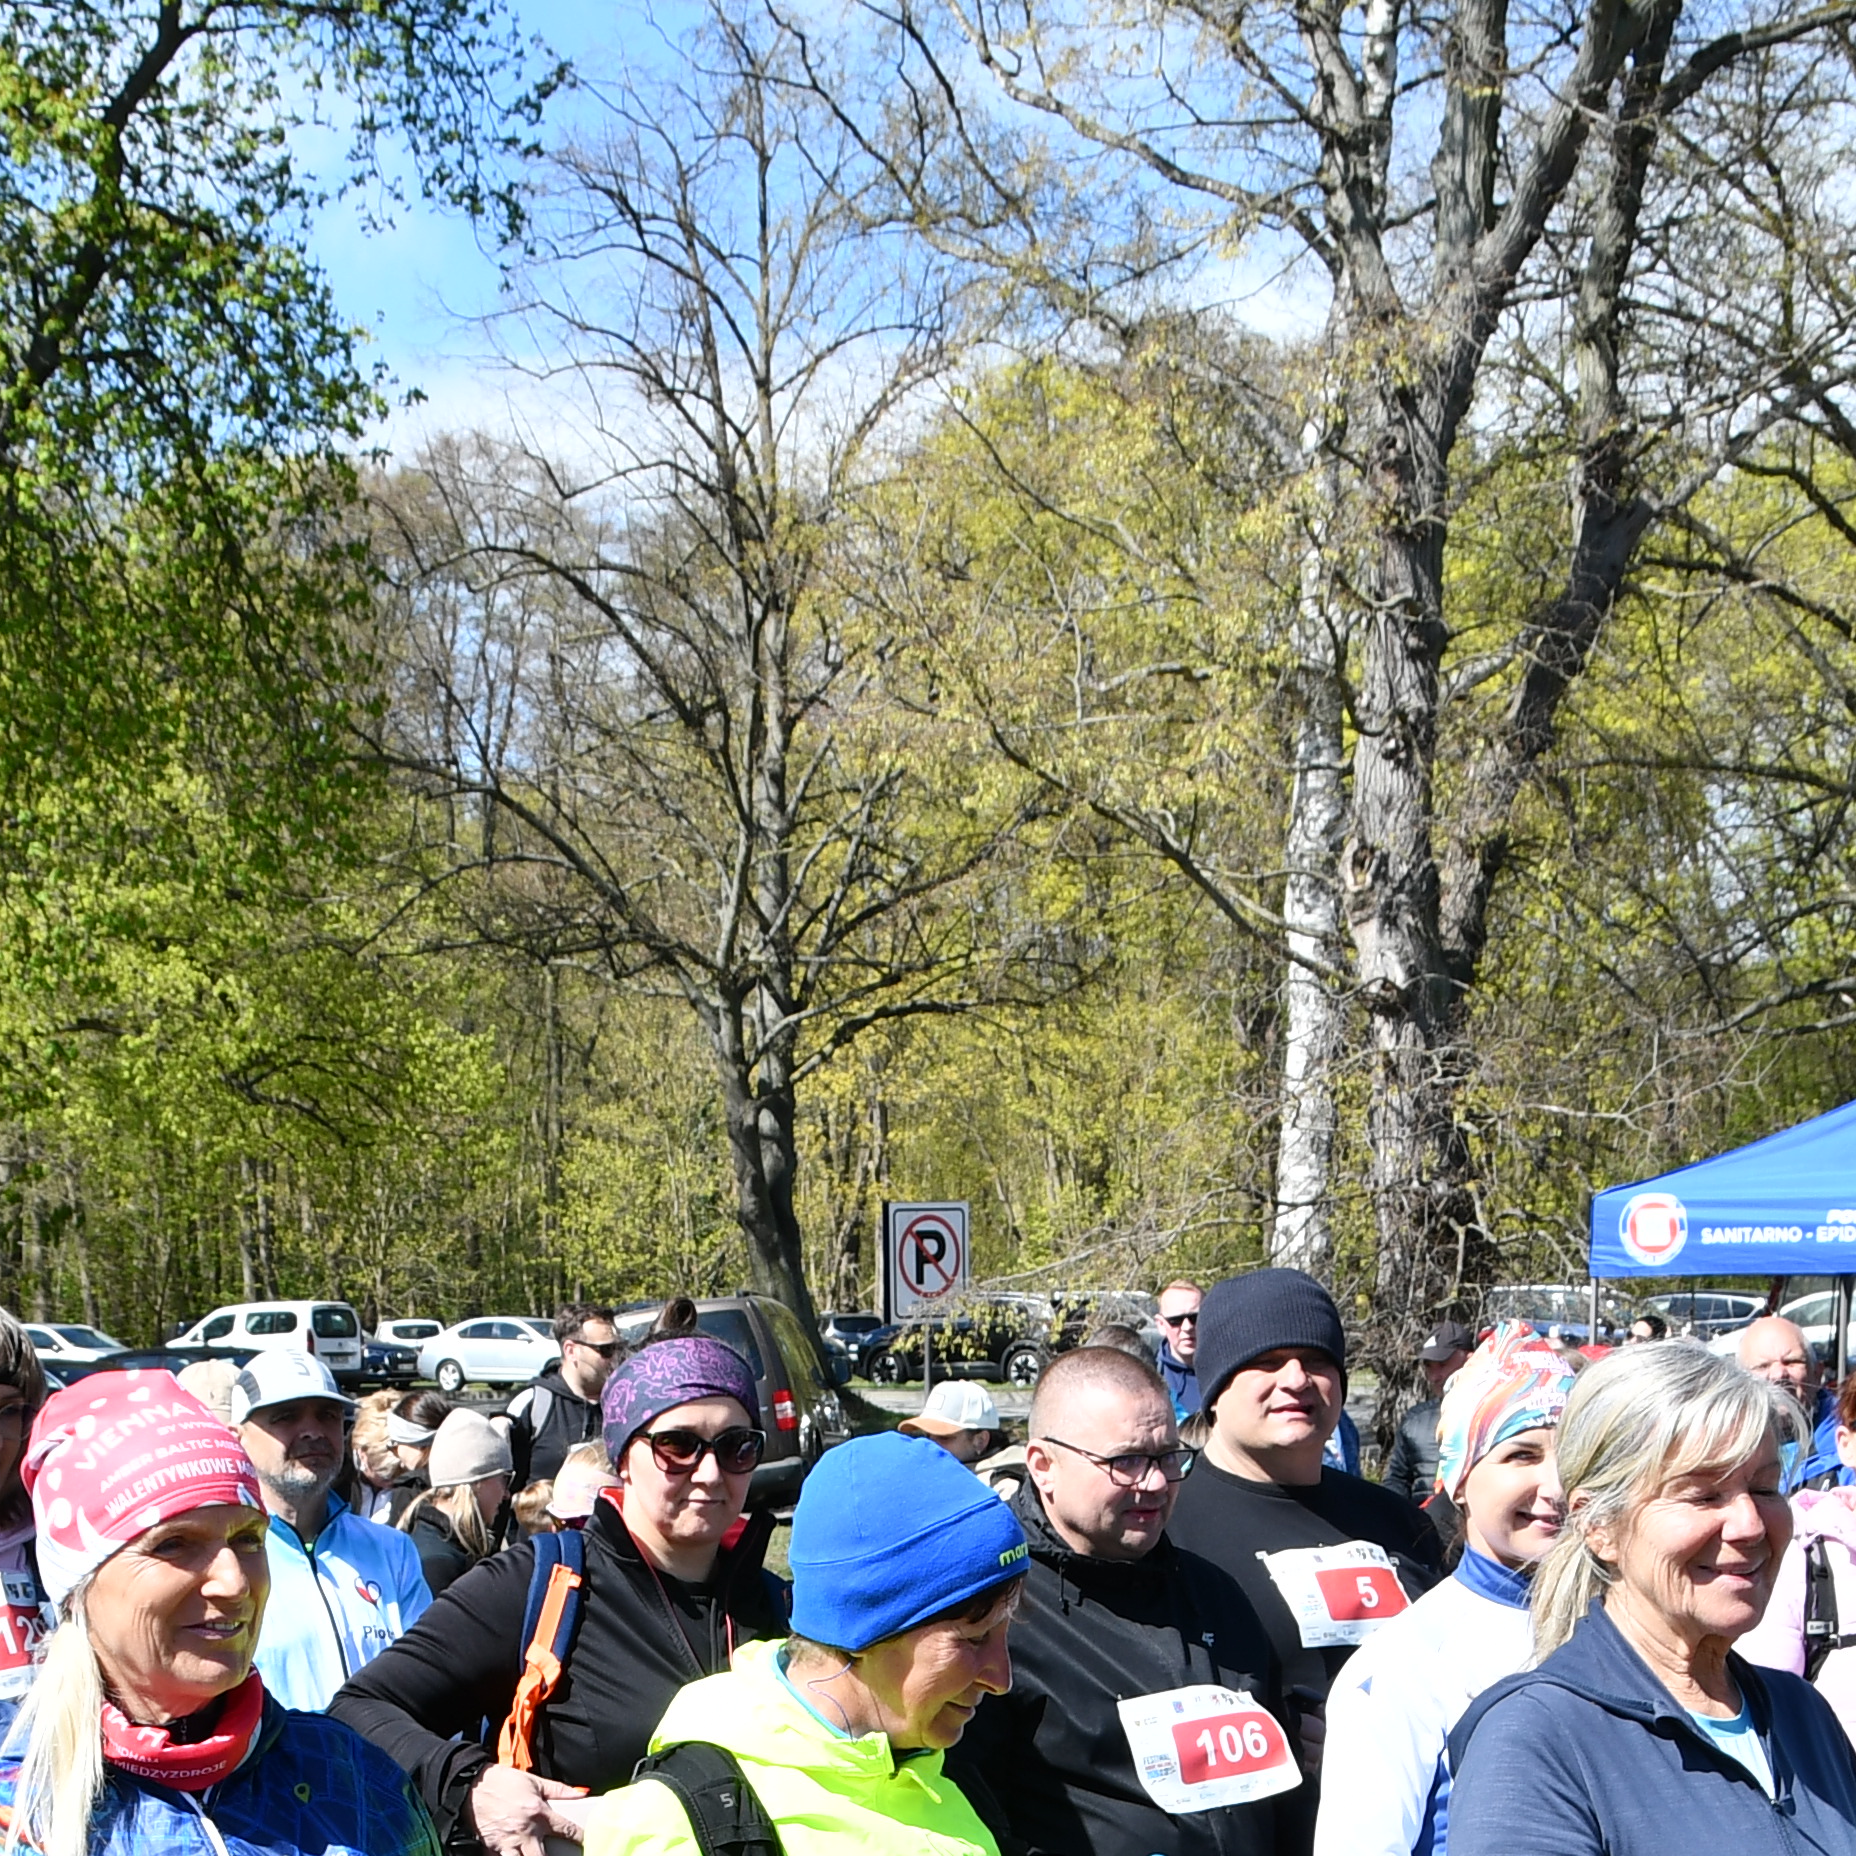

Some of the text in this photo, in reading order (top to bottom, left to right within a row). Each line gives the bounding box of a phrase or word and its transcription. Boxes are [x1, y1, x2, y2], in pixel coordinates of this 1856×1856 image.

[915, 1229, 947, 1285] P
[1701, 1226, 1803, 1245] SANITARNO
[74, 1401, 196, 1471] VIENNA
[100, 1452, 154, 1494] AMBER
[154, 1437, 214, 1460] BALTIC
[104, 1457, 236, 1519] WALENTYNKOWE
[1355, 1576, 1380, 1608] 5
[362, 1624, 395, 1641] Piot
[1196, 1720, 1269, 1767] 106
